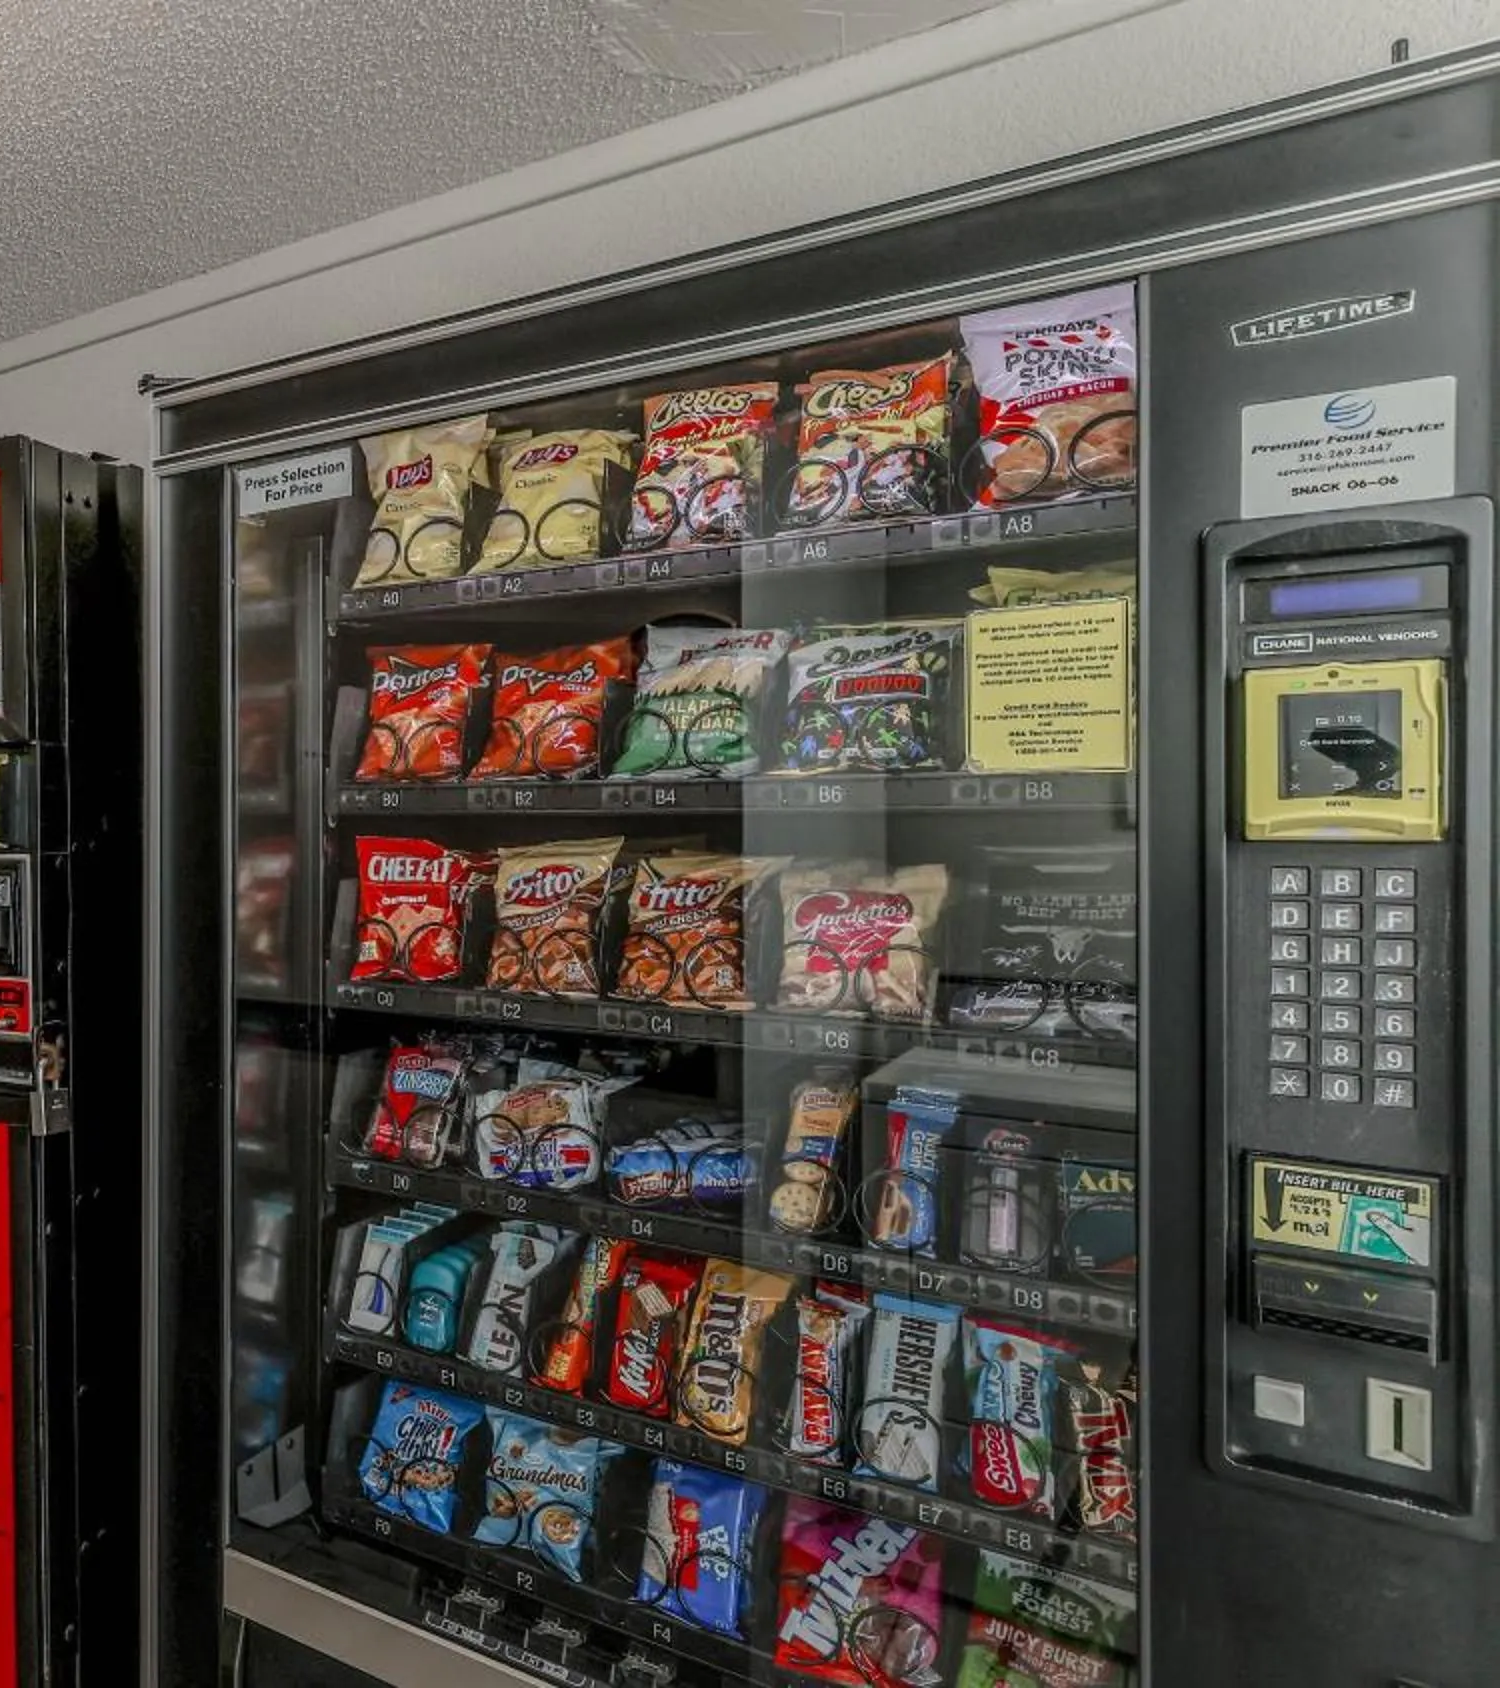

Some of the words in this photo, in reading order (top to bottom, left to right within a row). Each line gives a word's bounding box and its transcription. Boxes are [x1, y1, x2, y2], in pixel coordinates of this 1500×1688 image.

[1250, 296, 1394, 339] LIFETIME
[650, 390, 752, 432] Cheetos
[1251, 438, 1322, 455] Premier
[1326, 430, 1372, 444] Food
[1374, 422, 1446, 438] Service
[245, 475, 279, 490] Press
[281, 461, 345, 483] Selection
[264, 489, 286, 502] For
[289, 482, 323, 497] Price
[1291, 483, 1341, 497] SNACK
[1005, 515, 1033, 535] A8
[803, 540, 828, 559] A6
[651, 560, 671, 577] A4
[503, 578, 523, 593] A2
[383, 591, 400, 606] A0
[1260, 640, 1306, 650] CRANE
[1316, 634, 1375, 646] NATIONAL
[1378, 629, 1440, 641] VENDORS
[372, 662, 460, 692] Doritos
[515, 791, 534, 806] B2
[655, 788, 677, 805] B4
[818, 785, 843, 804] B6
[1025, 780, 1053, 800] B8
[507, 865, 585, 901] Fritos
[1282, 873, 1299, 893] A
[1335, 875, 1351, 894] B
[1387, 875, 1405, 895] C
[639, 878, 731, 912] Fritos
[1017, 905, 1061, 919] BEEF
[1069, 906, 1128, 921] JERKY
[1283, 907, 1299, 926] D
[1336, 909, 1350, 928] E
[1389, 911, 1404, 930] F
[1282, 940, 1299, 960] G
[1334, 943, 1351, 962] H
[1388, 946, 1403, 965] J
[1286, 974, 1296, 993] 1
[1334, 976, 1349, 996] 2
[1387, 980, 1403, 1000] 3
[503, 1003, 522, 1020] C2
[1281, 1007, 1297, 1026] 4
[1334, 1011, 1349, 1030] 5
[651, 1015, 672, 1034] C4
[1387, 1015, 1403, 1034] 6
[825, 1031, 850, 1050] C6
[1283, 1041, 1297, 1060] 7
[1030, 1047, 1060, 1068] C8
[1334, 1044, 1349, 1064] 8
[1387, 1049, 1403, 1069] 9
[1334, 1078, 1349, 1098] 0
[911, 1130, 926, 1169] Grain
[924, 1131, 942, 1171] Nutri
[393, 1173, 411, 1191] D0
[1073, 1168, 1135, 1193] Adv
[1277, 1170, 1327, 1189] INSERT
[1331, 1180, 1362, 1195] BILL
[1366, 1186, 1406, 1201] HERE
[507, 1196, 527, 1213] D2
[1290, 1194, 1332, 1207] ACCEPTS
[631, 1219, 654, 1237] D4
[823, 1253, 849, 1274] D6
[919, 1272, 947, 1293] D7
[1014, 1287, 1043, 1310] D8
[376, 1351, 393, 1368] E0
[440, 1369, 456, 1387] E1
[505, 1389, 524, 1407] E2
[1014, 1360, 1041, 1430] Chewy
[416, 1400, 449, 1421] Mini
[576, 1410, 595, 1428] E3
[644, 1428, 664, 1447] E4
[725, 1451, 746, 1471] E5
[823, 1478, 846, 1498] E6
[918, 1504, 943, 1525] E7
[375, 1518, 392, 1536] F0
[1006, 1529, 1032, 1551] E8
[516, 1571, 534, 1592] F2
[1020, 1581, 1091, 1619] BLACK
[1011, 1591, 1095, 1633] FOREST
[653, 1622, 671, 1643] F4
[985, 1617, 1042, 1650] JUICY
[1041, 1641, 1107, 1680] BURST
